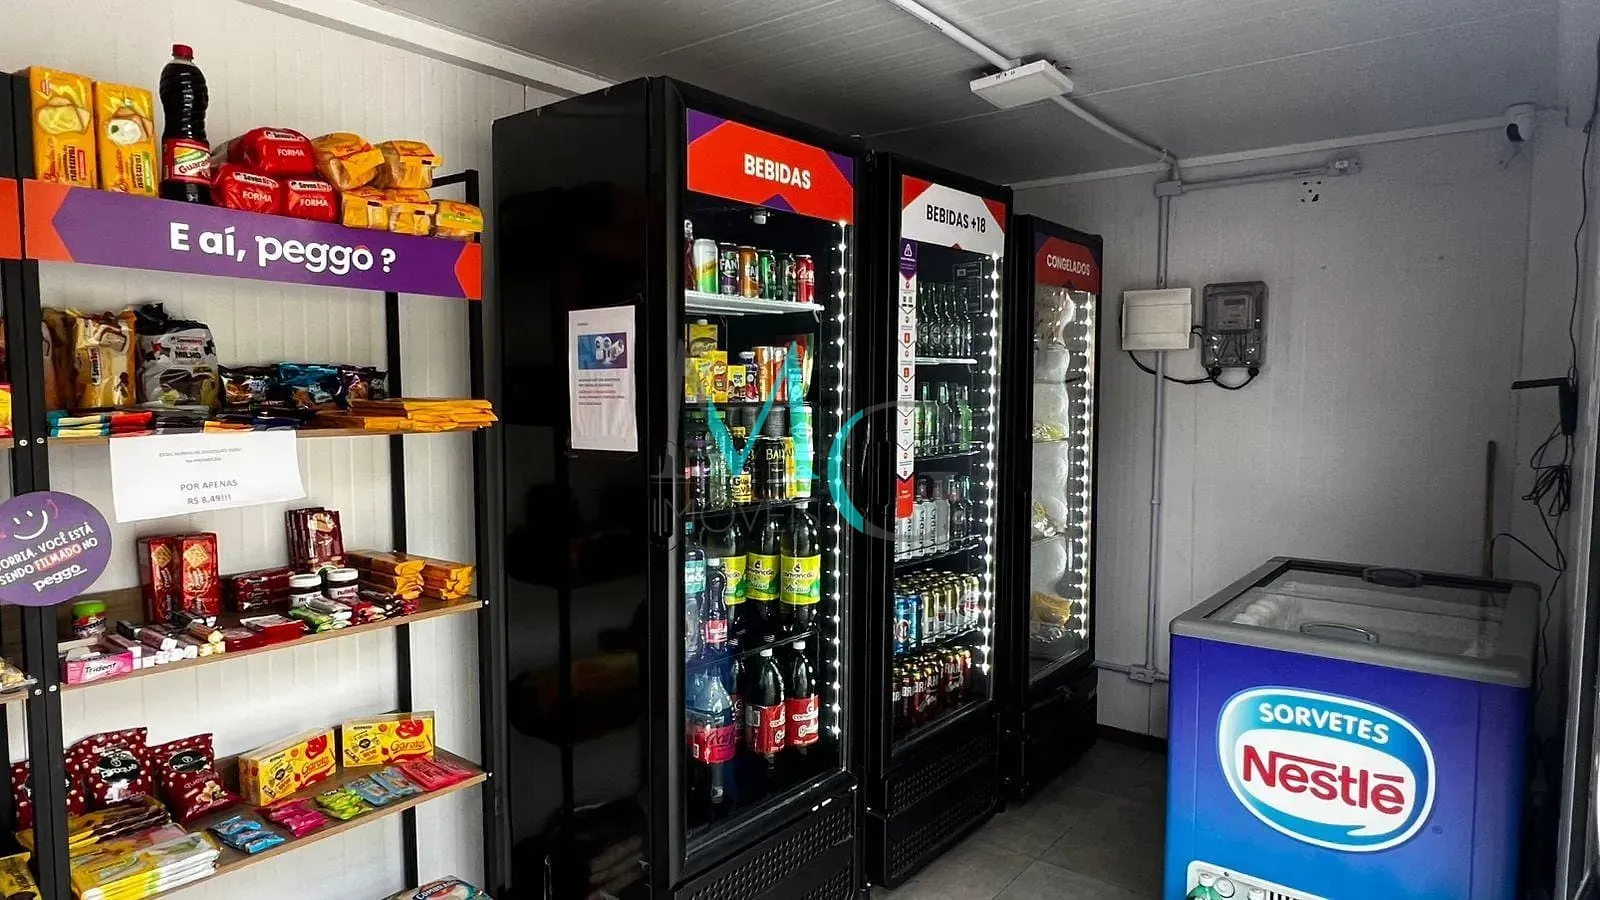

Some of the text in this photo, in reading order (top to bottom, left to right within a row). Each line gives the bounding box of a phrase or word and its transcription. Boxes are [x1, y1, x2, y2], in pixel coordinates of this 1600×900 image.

[277, 148, 305, 157] FORMA
[743, 153, 812, 190] BEBIDAS
[242, 190, 273, 203] FORMA
[300, 198, 329, 207] FORMA
[926, 204, 986, 233] BEBIDAS +18
[169, 221, 397, 276] E aí, peggo ?
[1046, 253, 1092, 277] CONGELADOS
[180, 479, 238, 492] POR APENAS
[0, 521, 94, 571] ORRIA. VOCÊ ESTÁ
[0, 537, 98, 586] SENDO FILMADO NO
[33, 564, 81, 592] peggo
[85, 662, 117, 674] Trident
[1258, 702, 1390, 745] SORVETES
[1242, 744, 1405, 815] Nestlé
